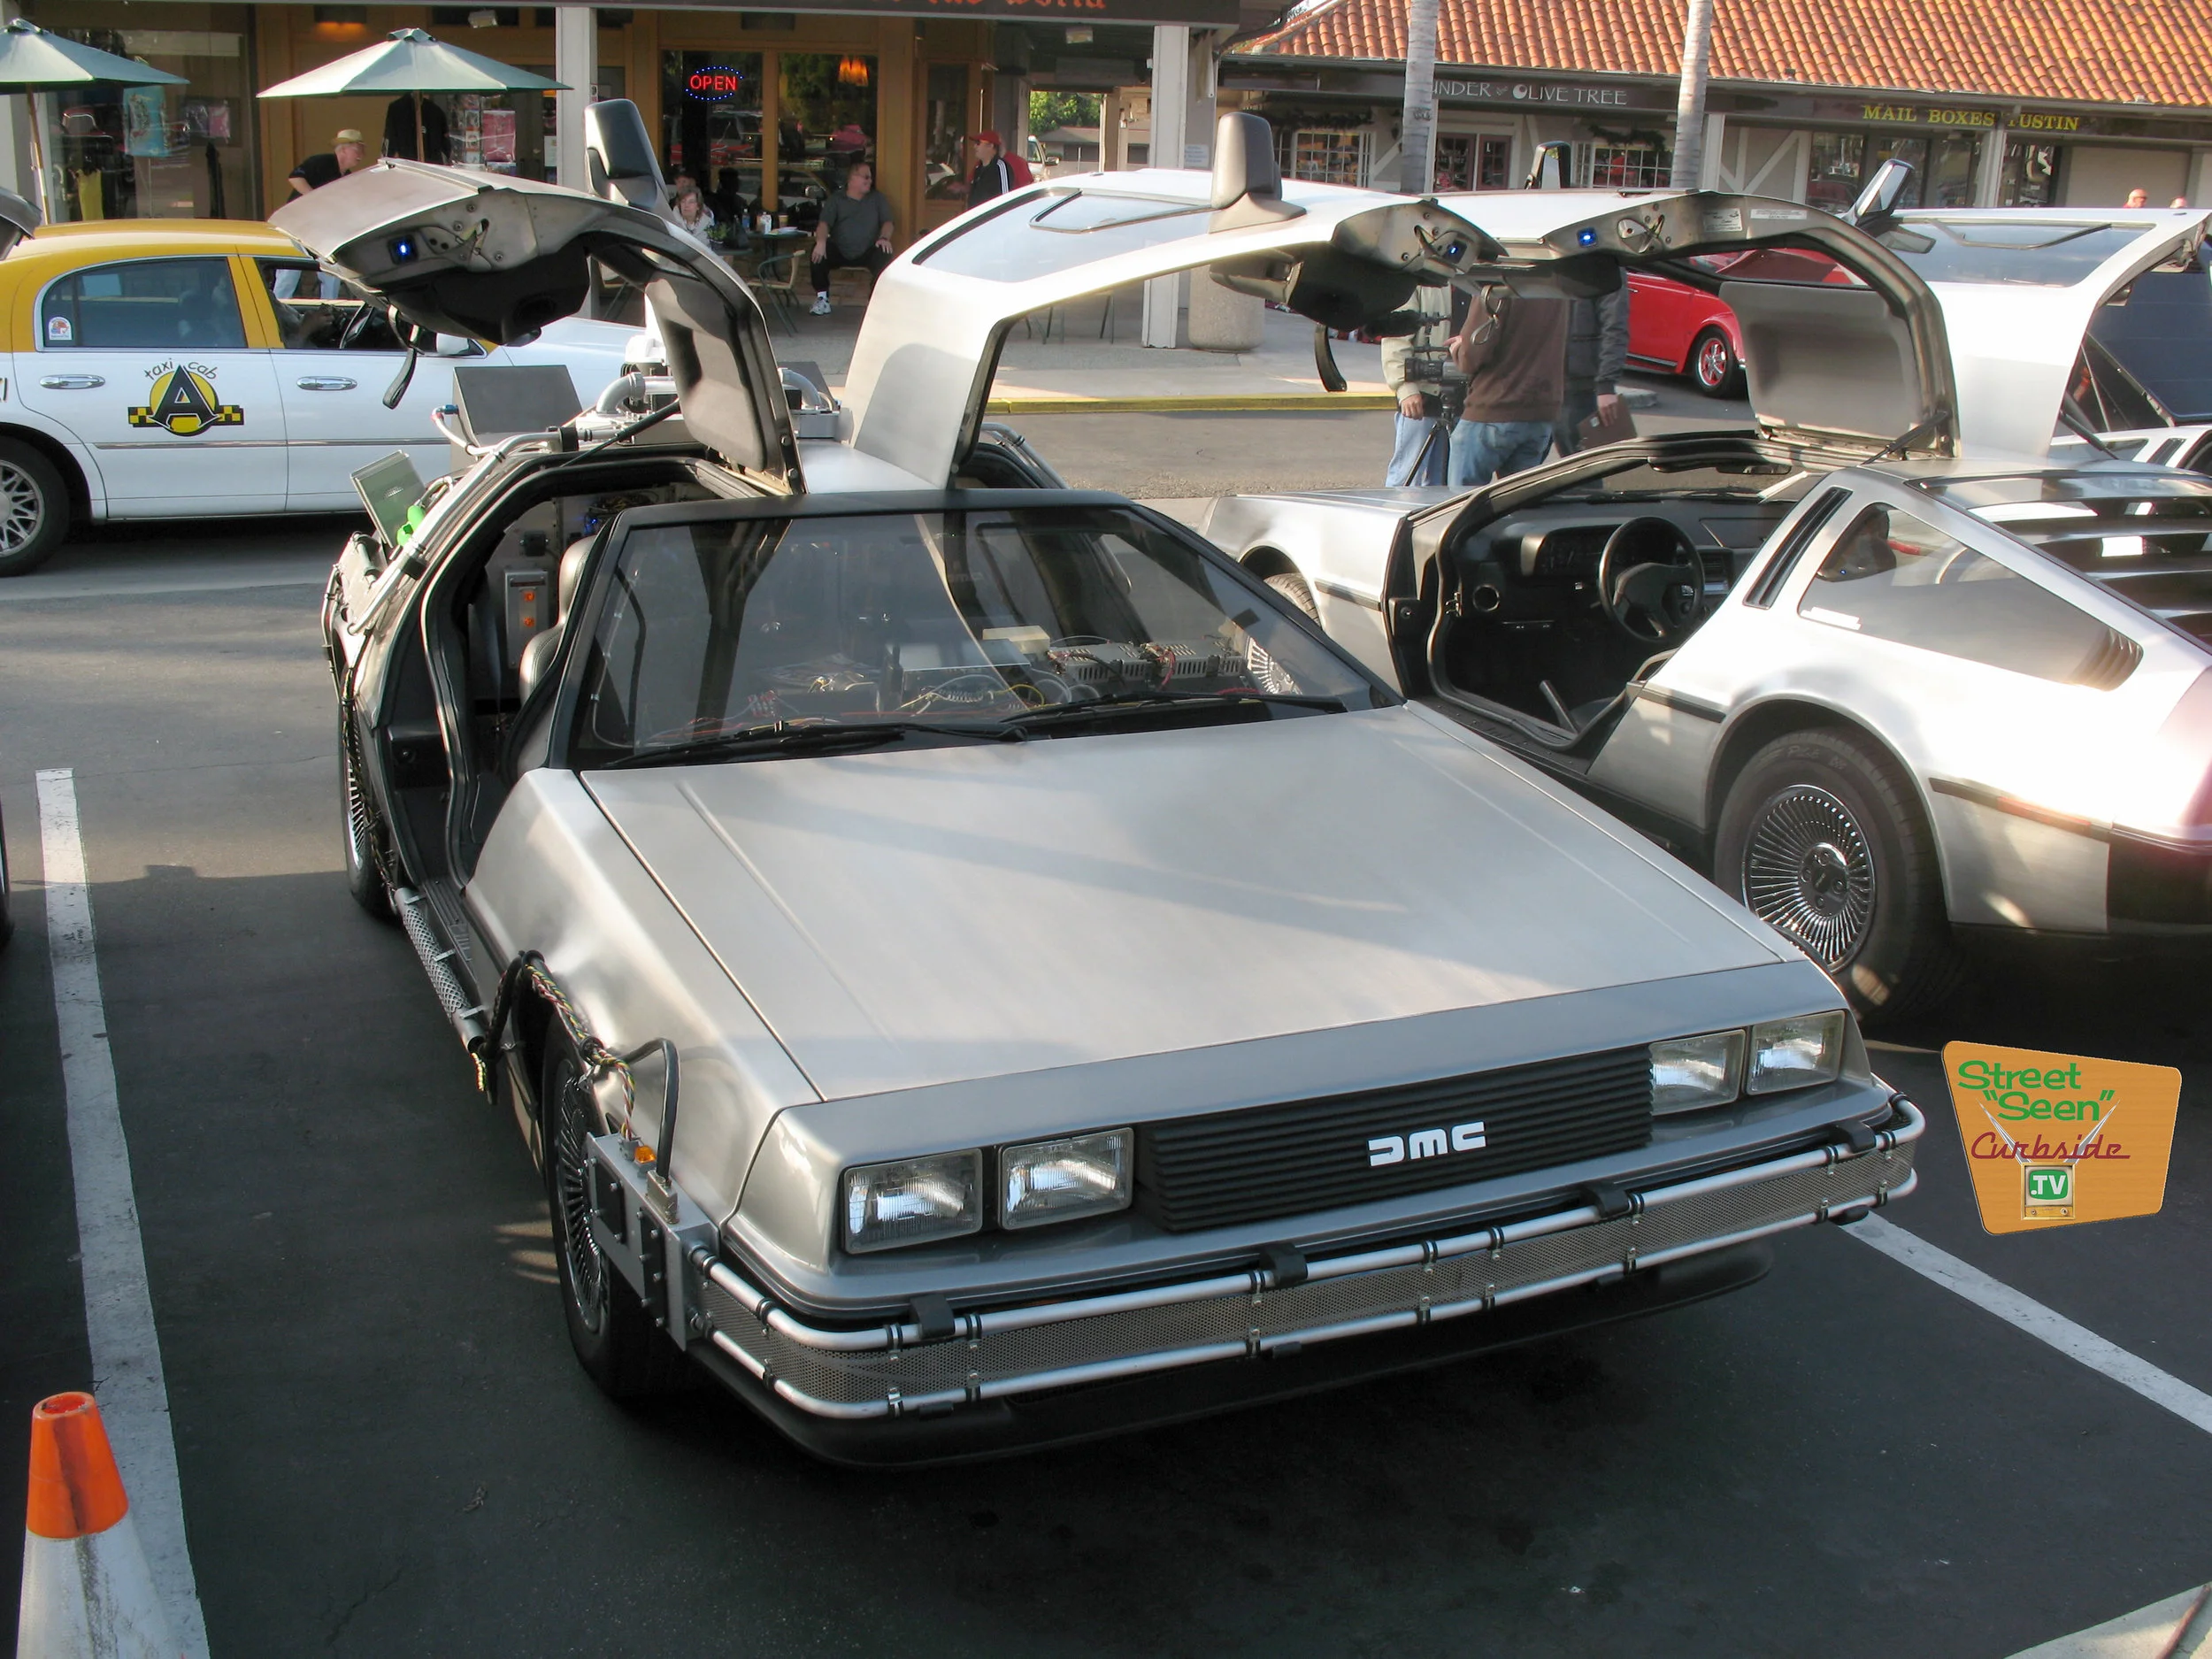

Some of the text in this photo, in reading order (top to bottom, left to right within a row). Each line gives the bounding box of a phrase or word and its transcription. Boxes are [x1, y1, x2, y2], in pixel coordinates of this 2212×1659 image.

[689, 74, 738, 90] OPEN
[1512, 84, 1569, 102] OLIVE
[1574, 88, 1627, 105] TREE
[1862, 104, 1917, 122] MAIL
[1927, 109, 1995, 127] BOXES
[143, 357, 219, 380] taxi cab
[147, 364, 220, 430] A
